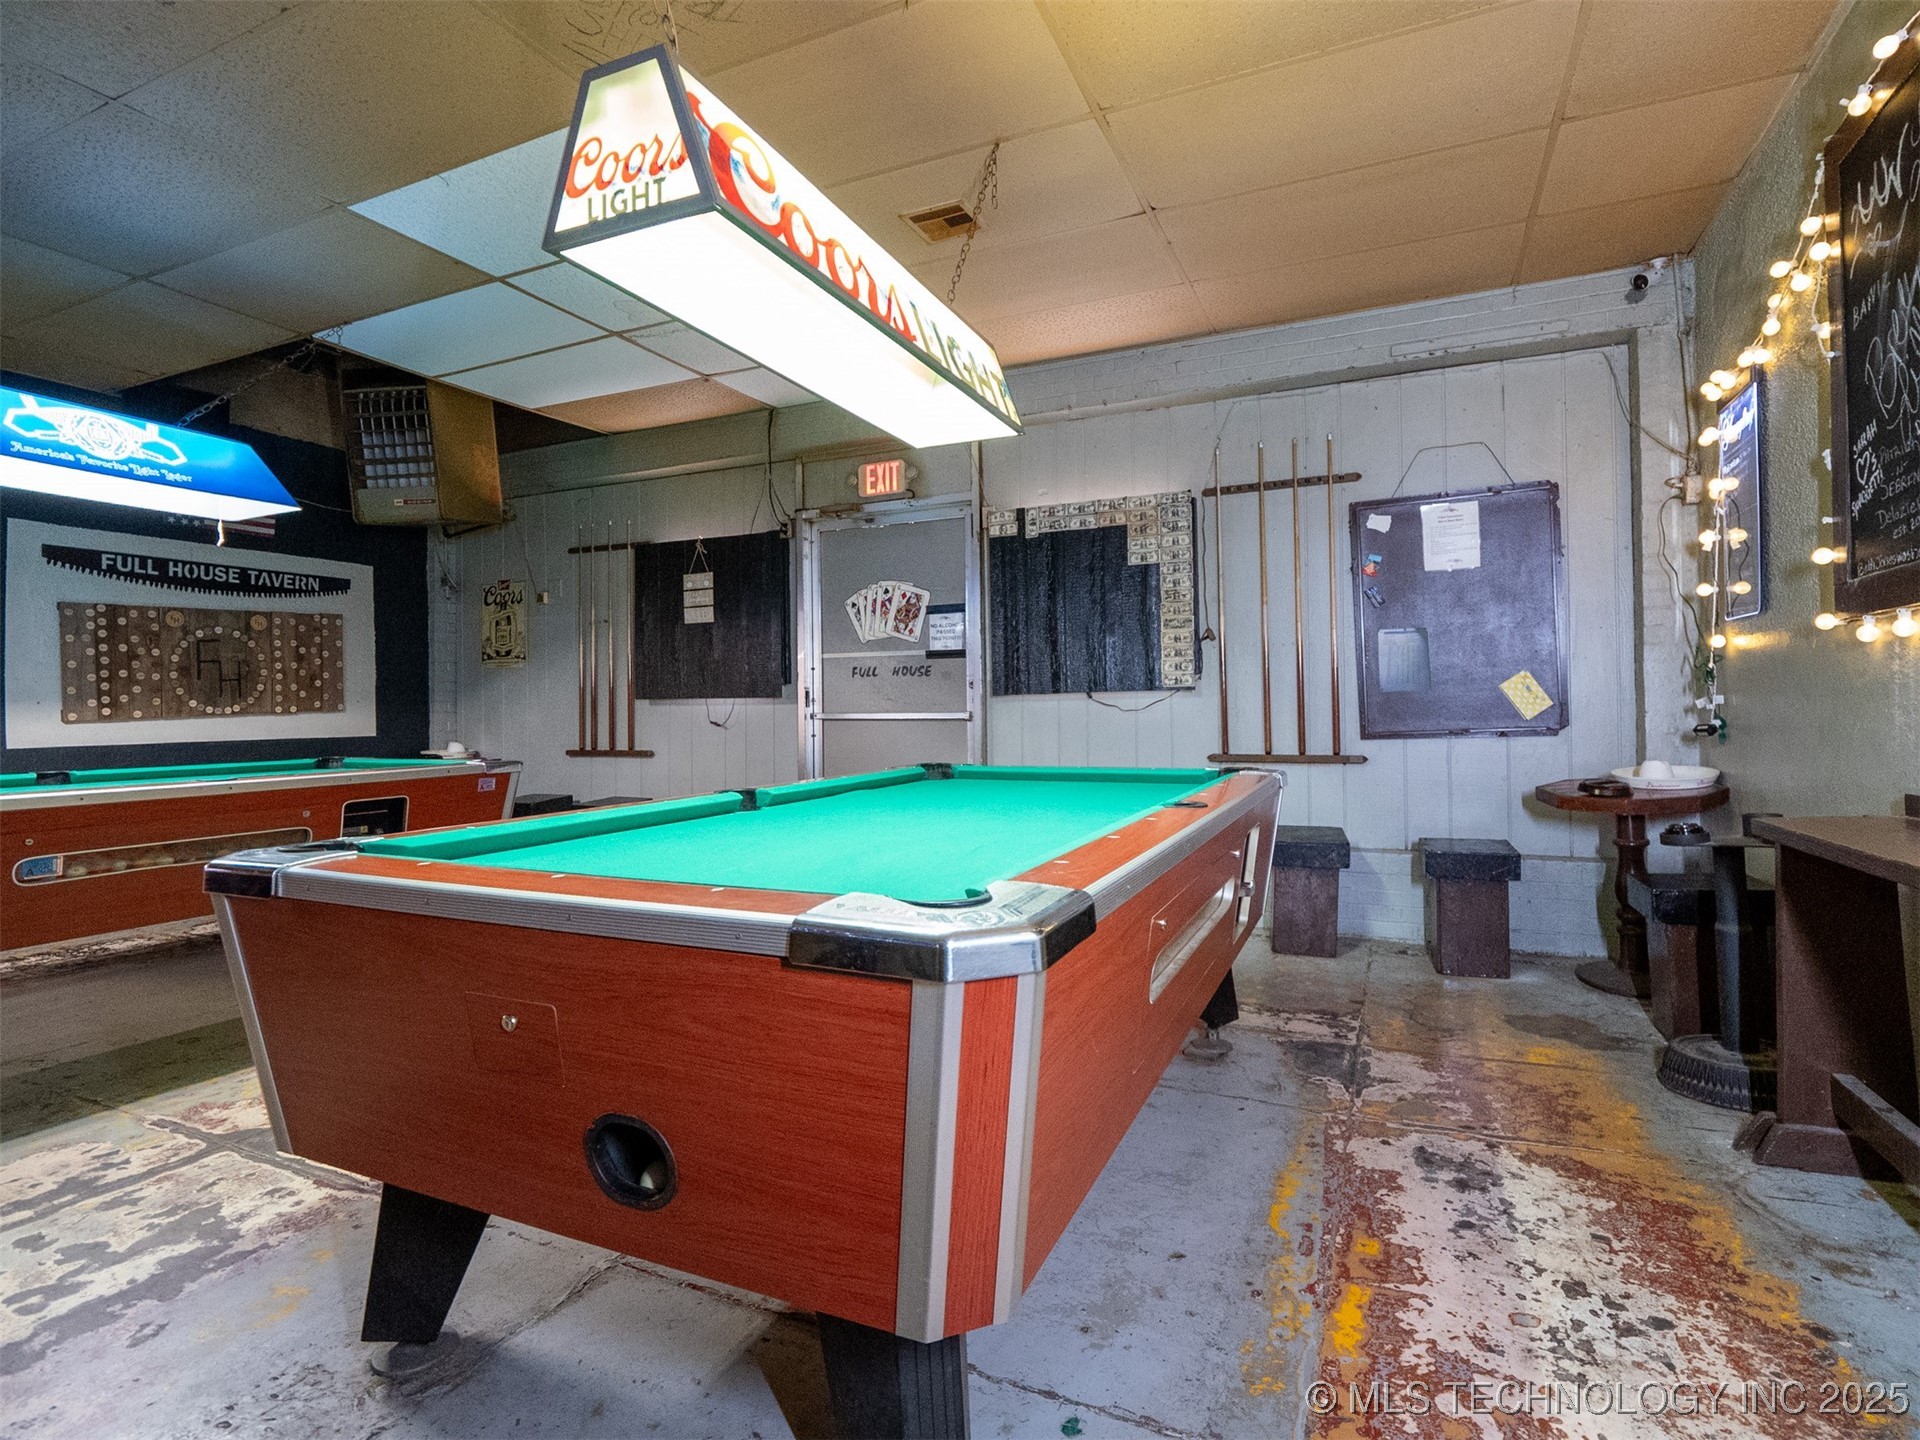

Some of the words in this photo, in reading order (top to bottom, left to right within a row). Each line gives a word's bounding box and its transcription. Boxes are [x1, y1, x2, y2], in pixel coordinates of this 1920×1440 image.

[565, 133, 689, 199] Coors
[587, 176, 666, 224] LIGHT
[686, 91, 918, 342] Coors
[908, 299, 1013, 420] LIGHT
[866, 460, 899, 495] EXIT
[101, 553, 159, 577] FULL
[168, 561, 241, 585] HOUSE
[248, 571, 320, 592] TAVERN
[483, 585, 524, 607] Coors
[851, 666, 879, 678] FULL
[891, 664, 933, 678] HOUSE
